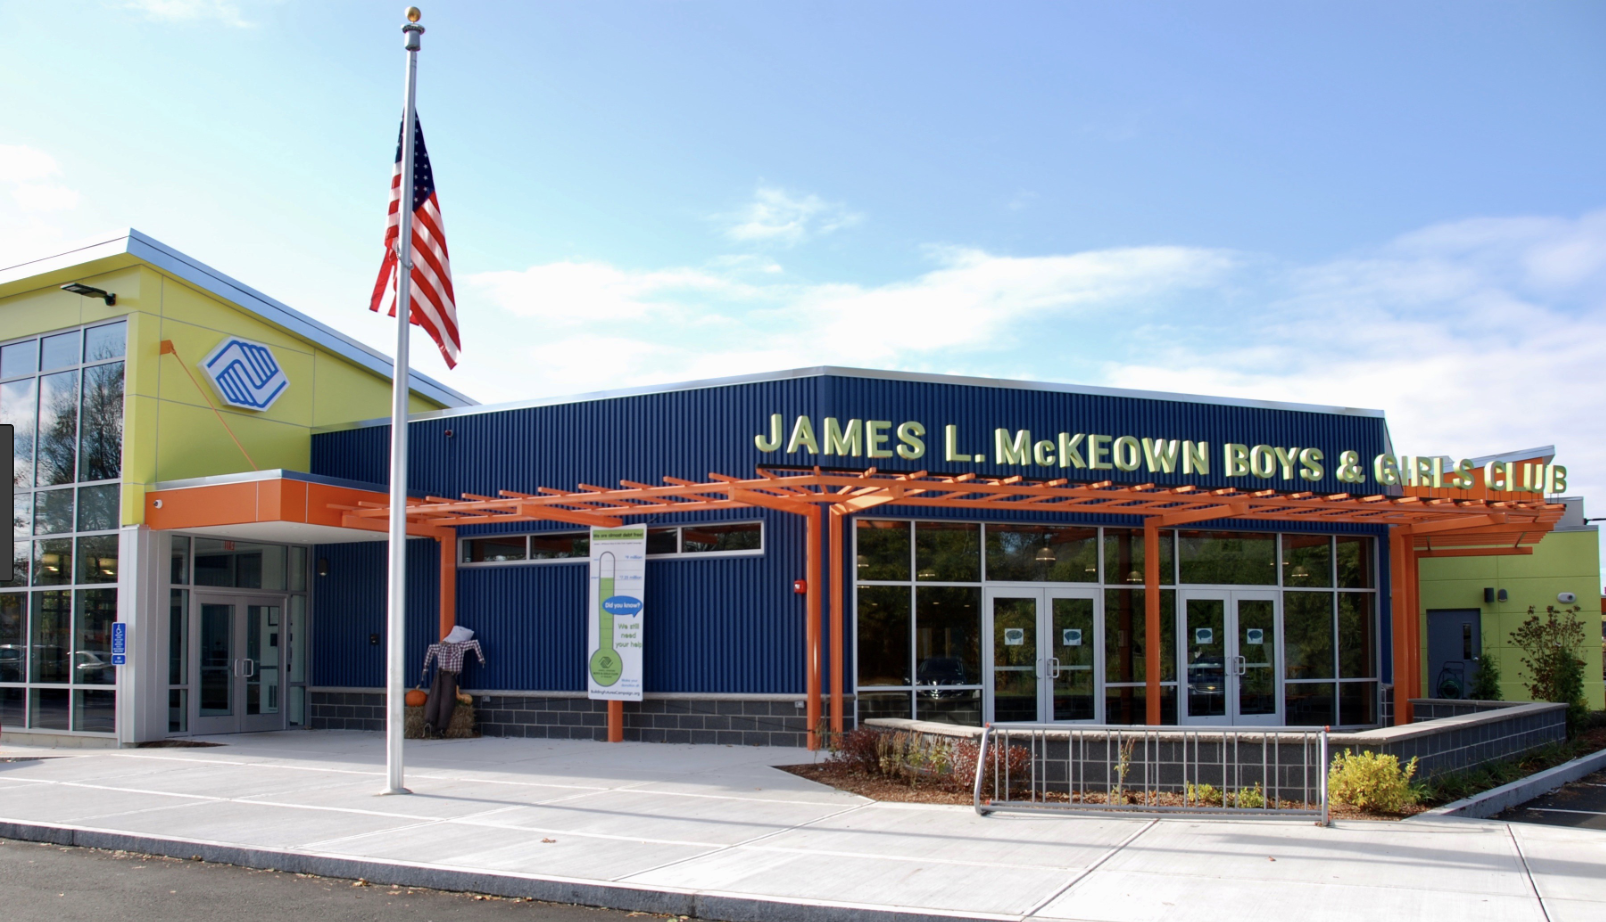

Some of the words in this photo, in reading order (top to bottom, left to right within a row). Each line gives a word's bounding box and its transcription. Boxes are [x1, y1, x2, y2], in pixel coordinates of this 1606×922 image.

[755, 414, 926, 460] JAMES
[945, 424, 985, 463] L.
[995, 428, 1210, 475] McKEOWN
[1224, 443, 1324, 481] BOYS
[1336, 450, 1366, 483] &
[1374, 453, 1475, 490] GIRLS
[1484, 460, 1567, 494] CLUB
